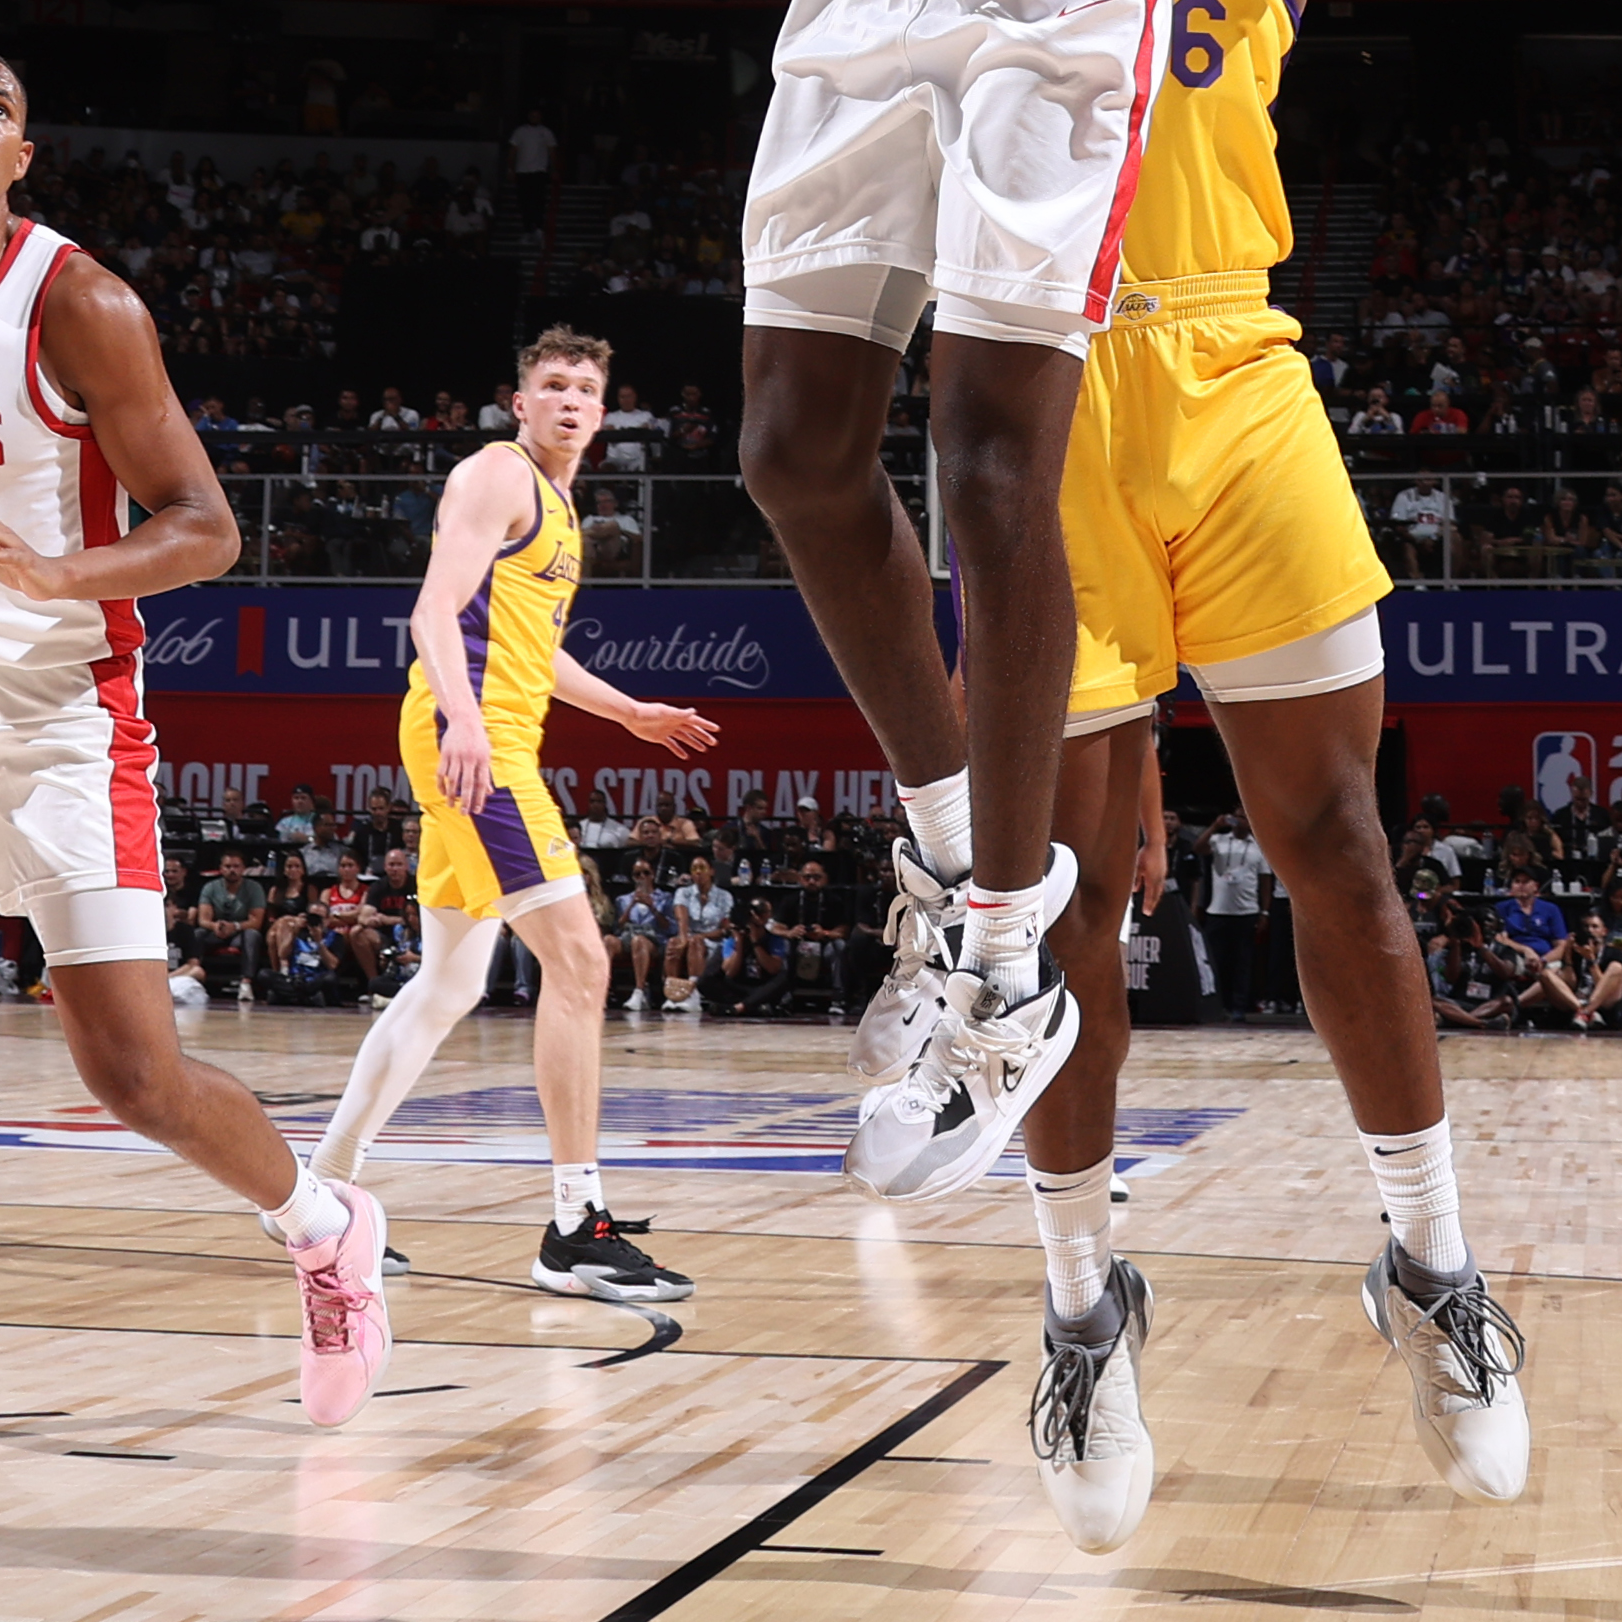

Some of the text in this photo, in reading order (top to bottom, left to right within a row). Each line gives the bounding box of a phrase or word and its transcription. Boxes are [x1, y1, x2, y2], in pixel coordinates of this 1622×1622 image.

[286, 616, 412, 670] ULT
[566, 617, 772, 691] Courtside
[593, 767, 712, 826] STARS
